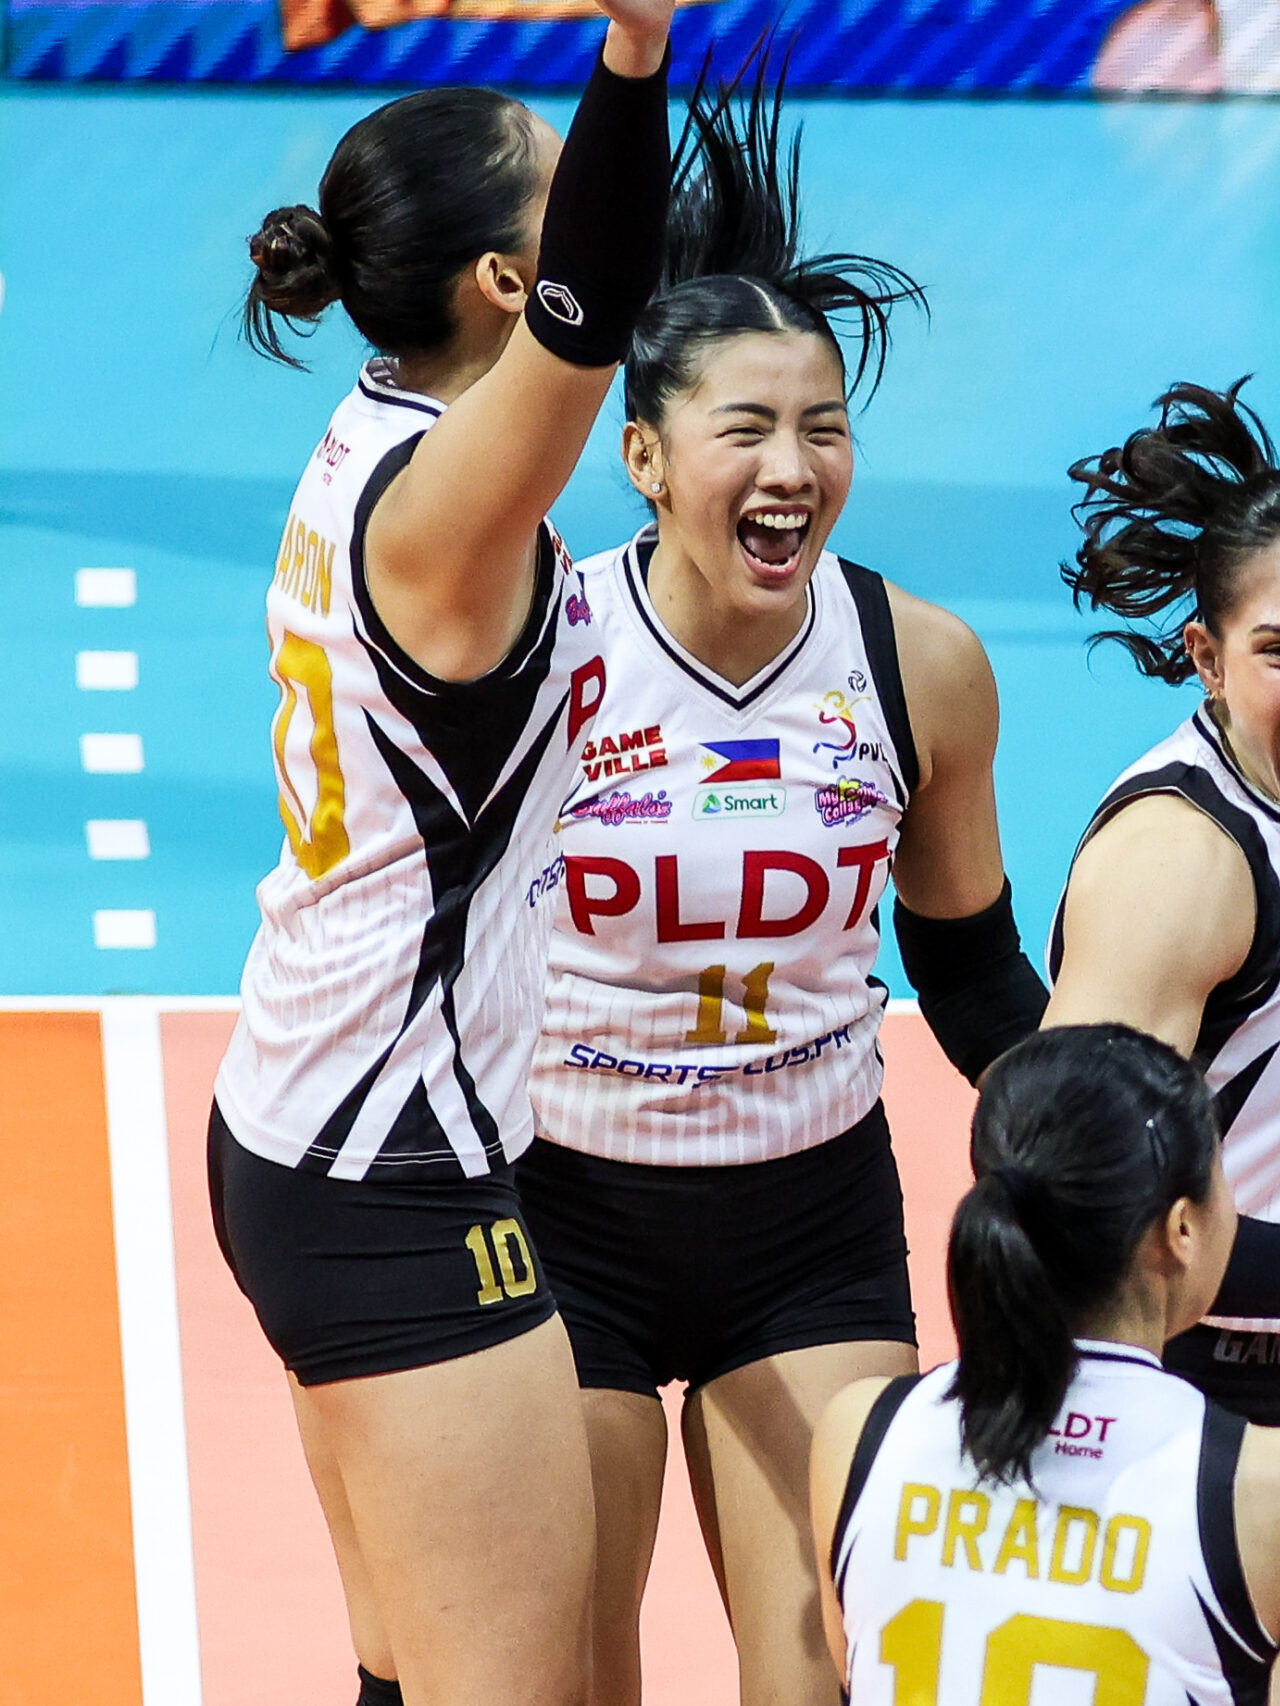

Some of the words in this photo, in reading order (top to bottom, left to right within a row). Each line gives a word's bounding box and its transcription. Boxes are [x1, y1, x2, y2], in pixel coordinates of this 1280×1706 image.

[581, 724, 663, 761] GAME
[583, 748, 668, 782] VILLE
[724, 793, 778, 813] Smart
[563, 836, 890, 944] PLDT
[686, 961, 778, 1045] 11
[465, 1217, 537, 1306] 10
[1054, 1441, 1104, 1461] Home
[894, 1482, 1153, 1595] PRADO
